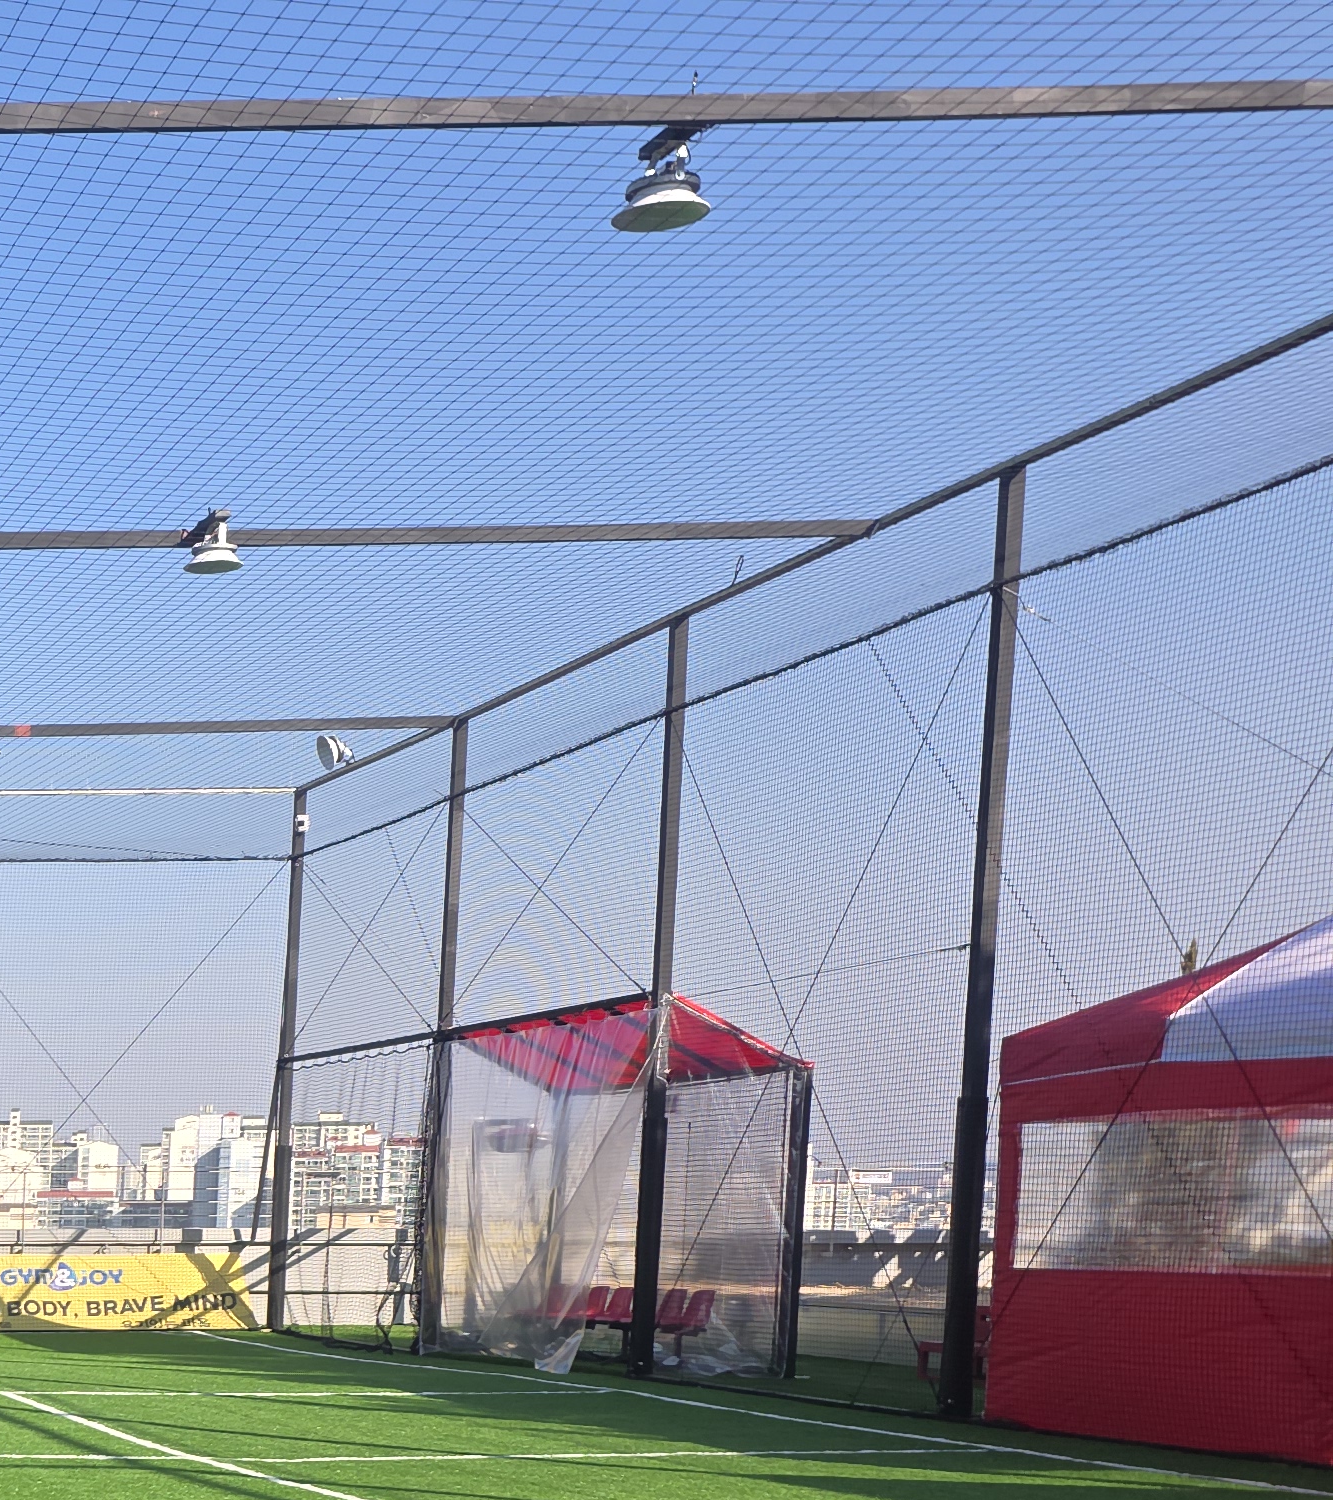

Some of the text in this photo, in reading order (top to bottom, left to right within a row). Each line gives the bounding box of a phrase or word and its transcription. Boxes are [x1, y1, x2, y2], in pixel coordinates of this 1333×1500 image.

[7, 1299, 79, 1319] BODY,
[86, 1294, 166, 1317] BRAVE
[171, 1292, 237, 1313] MIND
